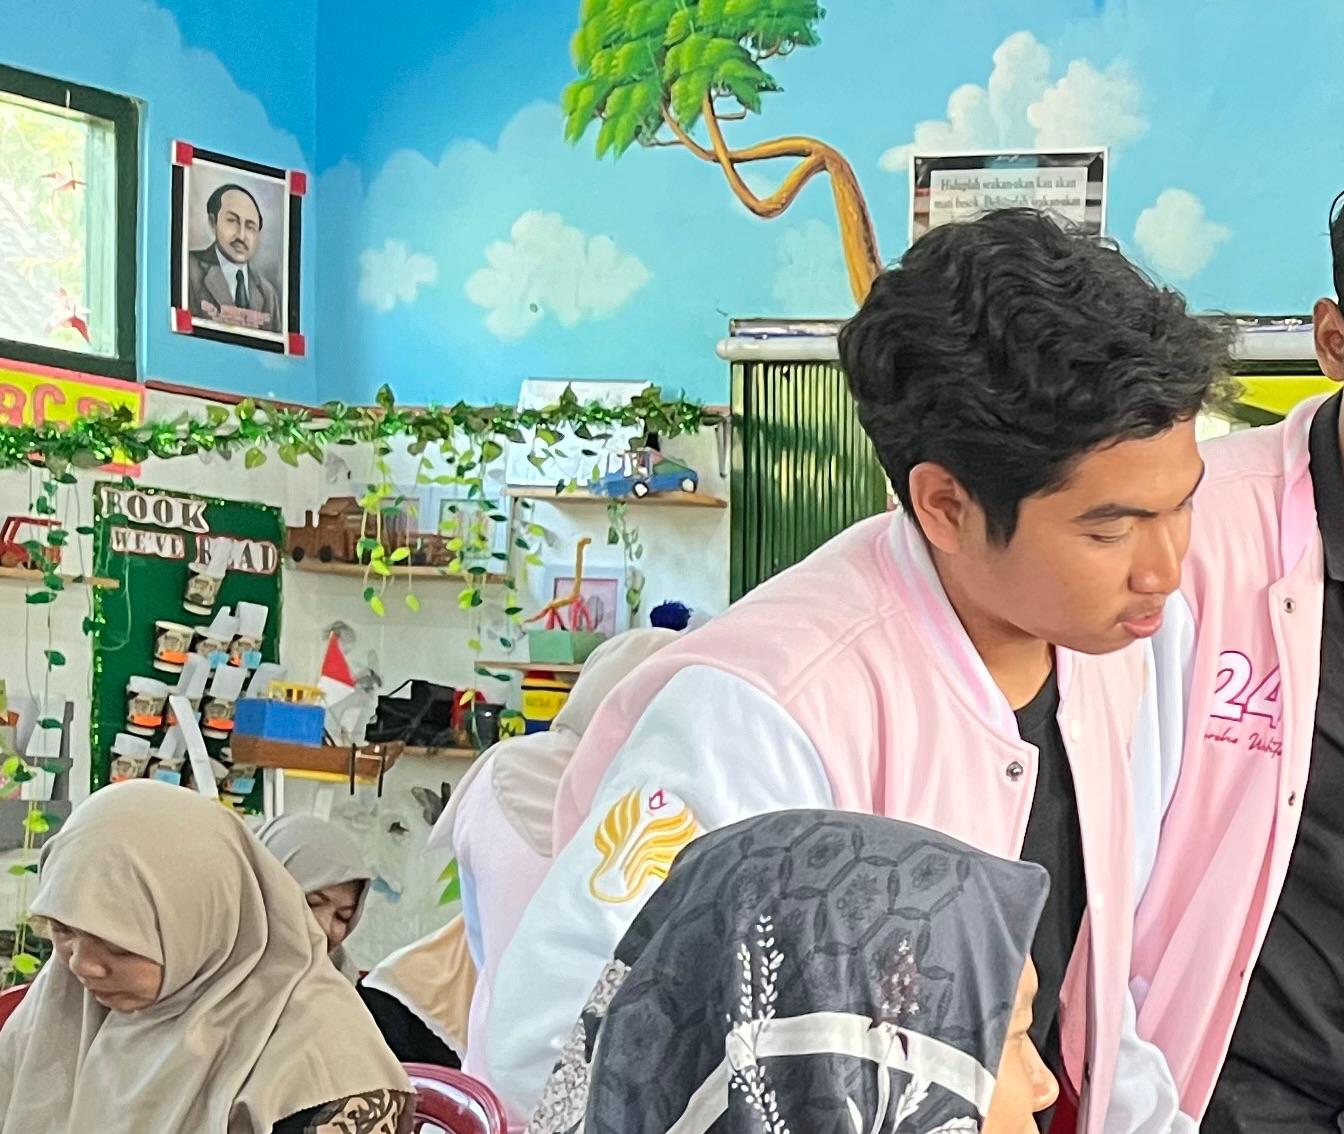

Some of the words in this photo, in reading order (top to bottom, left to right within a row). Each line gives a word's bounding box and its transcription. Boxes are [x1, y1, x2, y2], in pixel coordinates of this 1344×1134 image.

[103, 488, 208, 530] BOOK
[197, 536, 278, 573] RAD
[1209, 650, 1281, 730] 24
